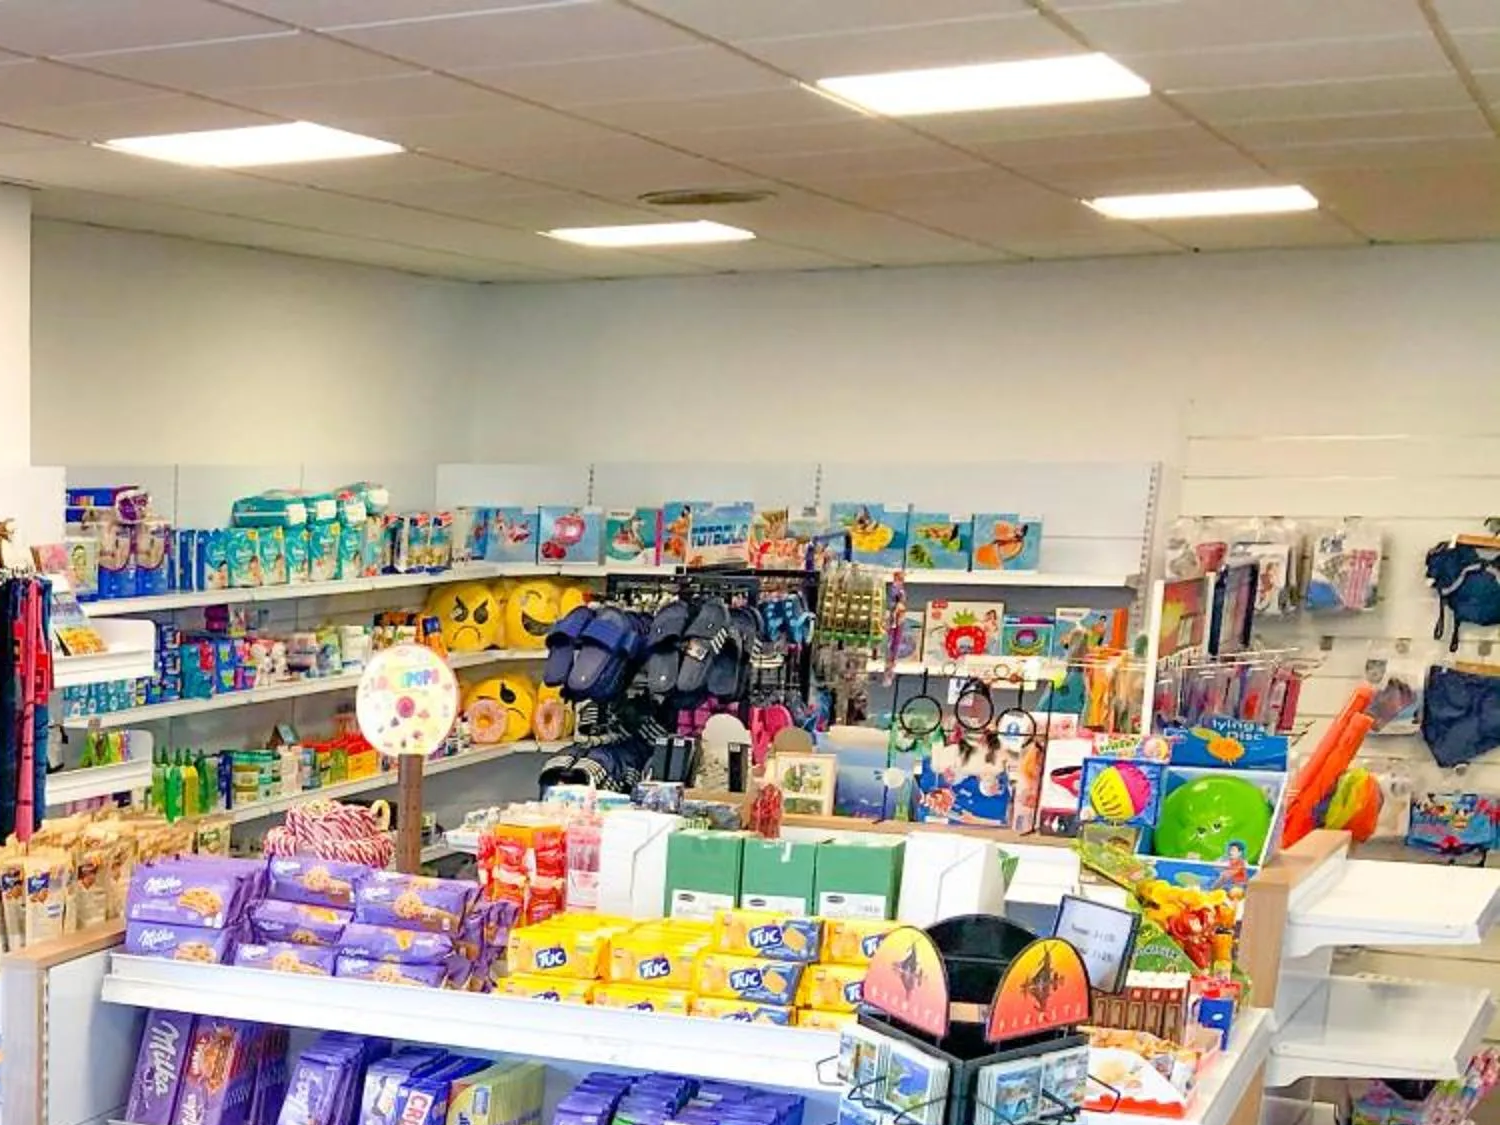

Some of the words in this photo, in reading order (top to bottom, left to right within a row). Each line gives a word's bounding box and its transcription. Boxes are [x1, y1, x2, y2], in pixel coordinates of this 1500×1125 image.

[143, 875, 183, 897] Milka
[137, 928, 176, 951] Milka
[750, 928, 781, 946] TUC
[538, 949, 566, 967] TUC
[639, 958, 670, 977] TUC
[730, 970, 762, 988] TUC
[150, 1018, 178, 1097] Milka
